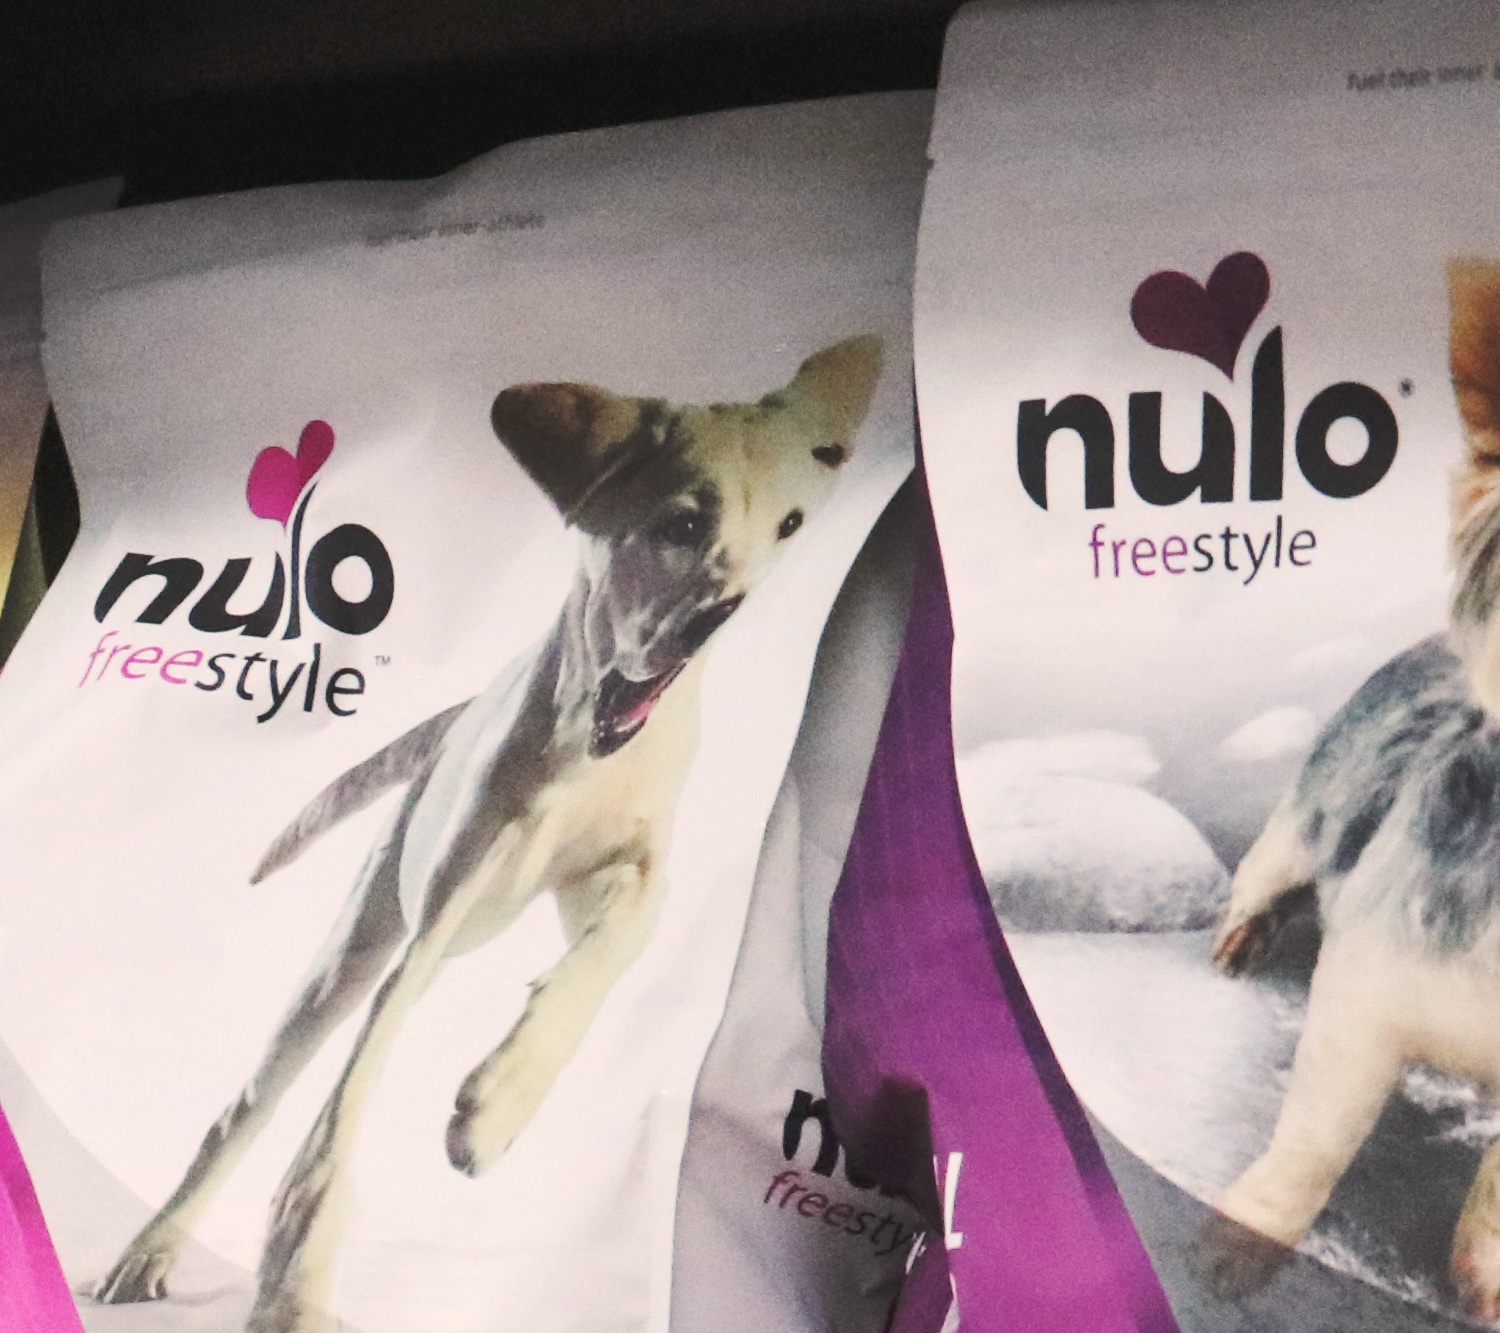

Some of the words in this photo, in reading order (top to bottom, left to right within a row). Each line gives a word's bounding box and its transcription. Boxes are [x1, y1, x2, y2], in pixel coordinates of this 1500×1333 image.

[1016, 325, 1399, 511] nulo
[93, 482, 394, 640] nulo
[1089, 515, 1317, 586] freestyle
[78, 630, 366, 723] freestyle
